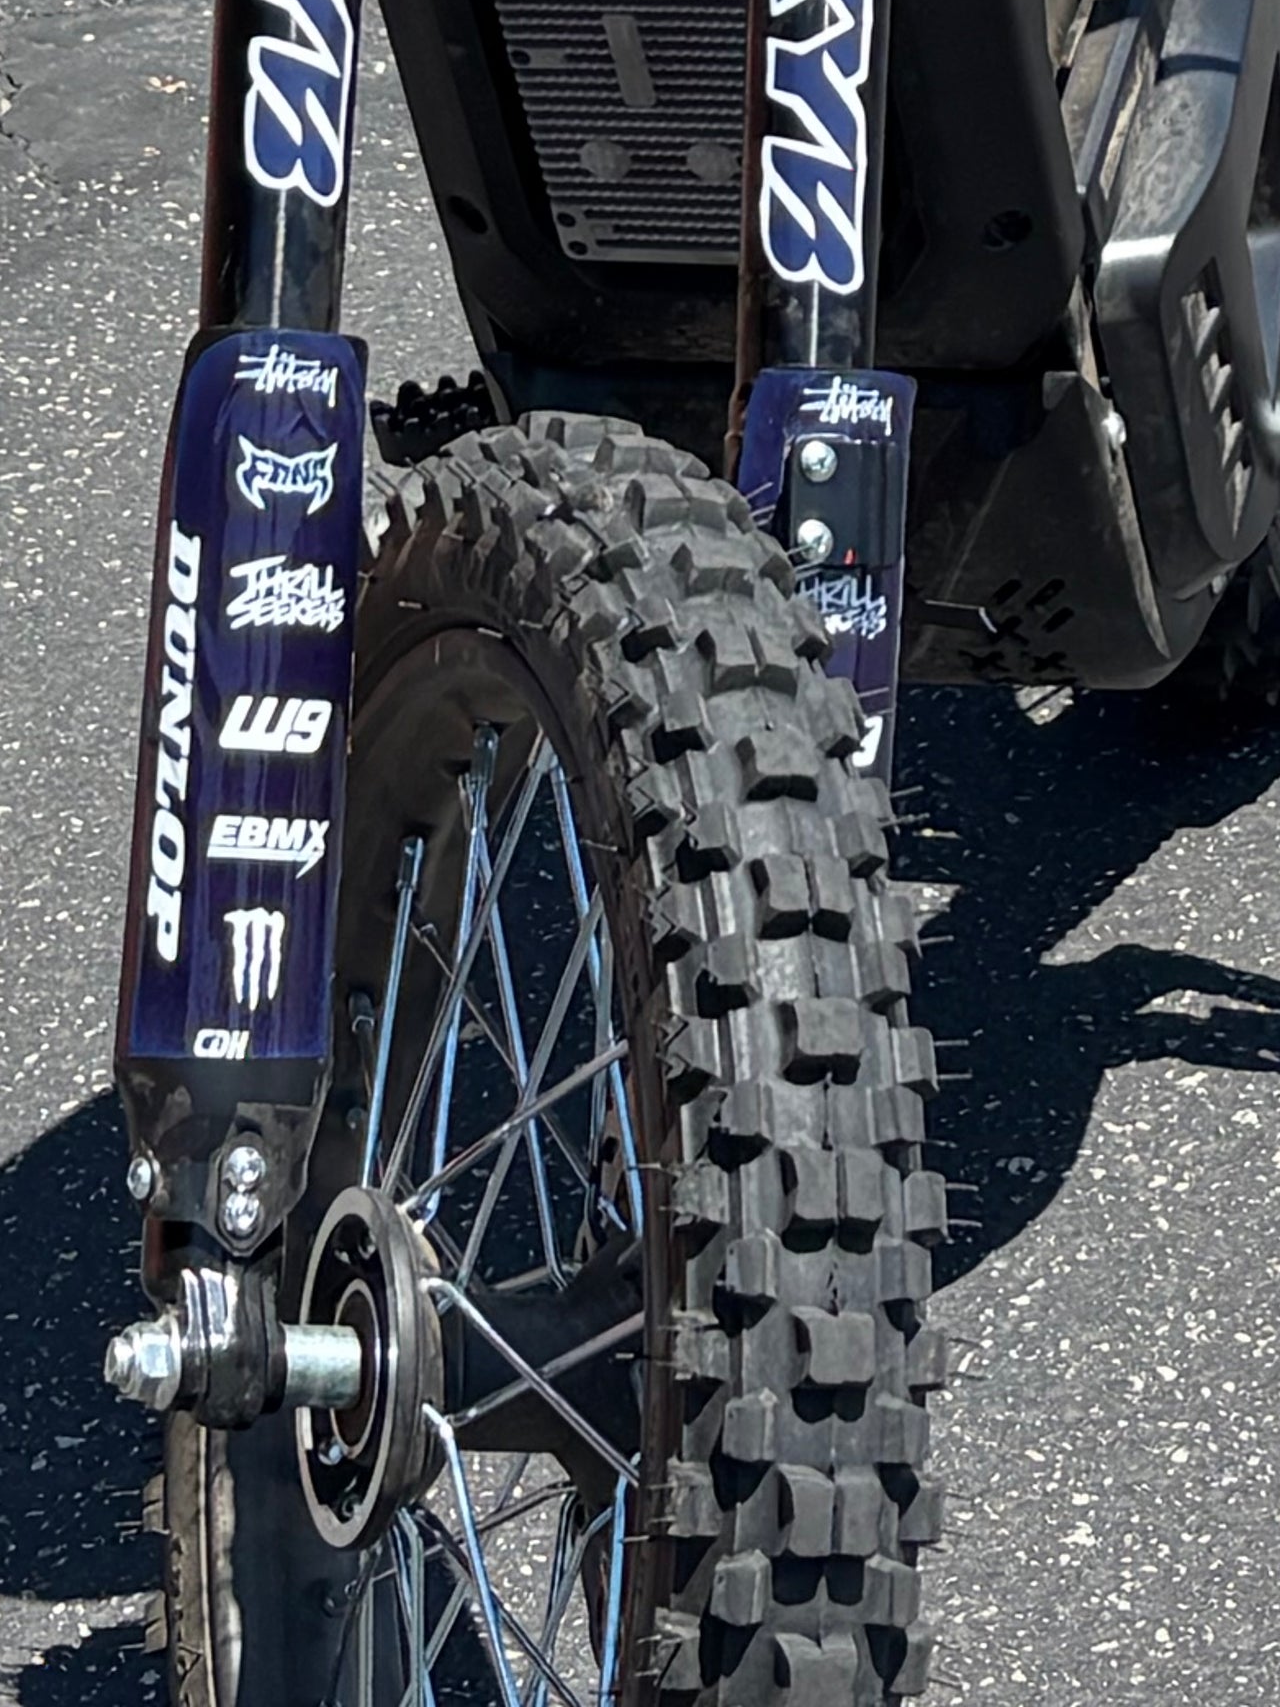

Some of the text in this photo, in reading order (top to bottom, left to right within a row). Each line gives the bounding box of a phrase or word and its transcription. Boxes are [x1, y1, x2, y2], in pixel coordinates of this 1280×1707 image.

[230, 555, 344, 599] THRILL
[799, 574, 886, 614] HRILL
[226, 591, 346, 633] SEEKERS
[147, 519, 201, 963] DUNLOP
[207, 815, 329, 871] EBMX
